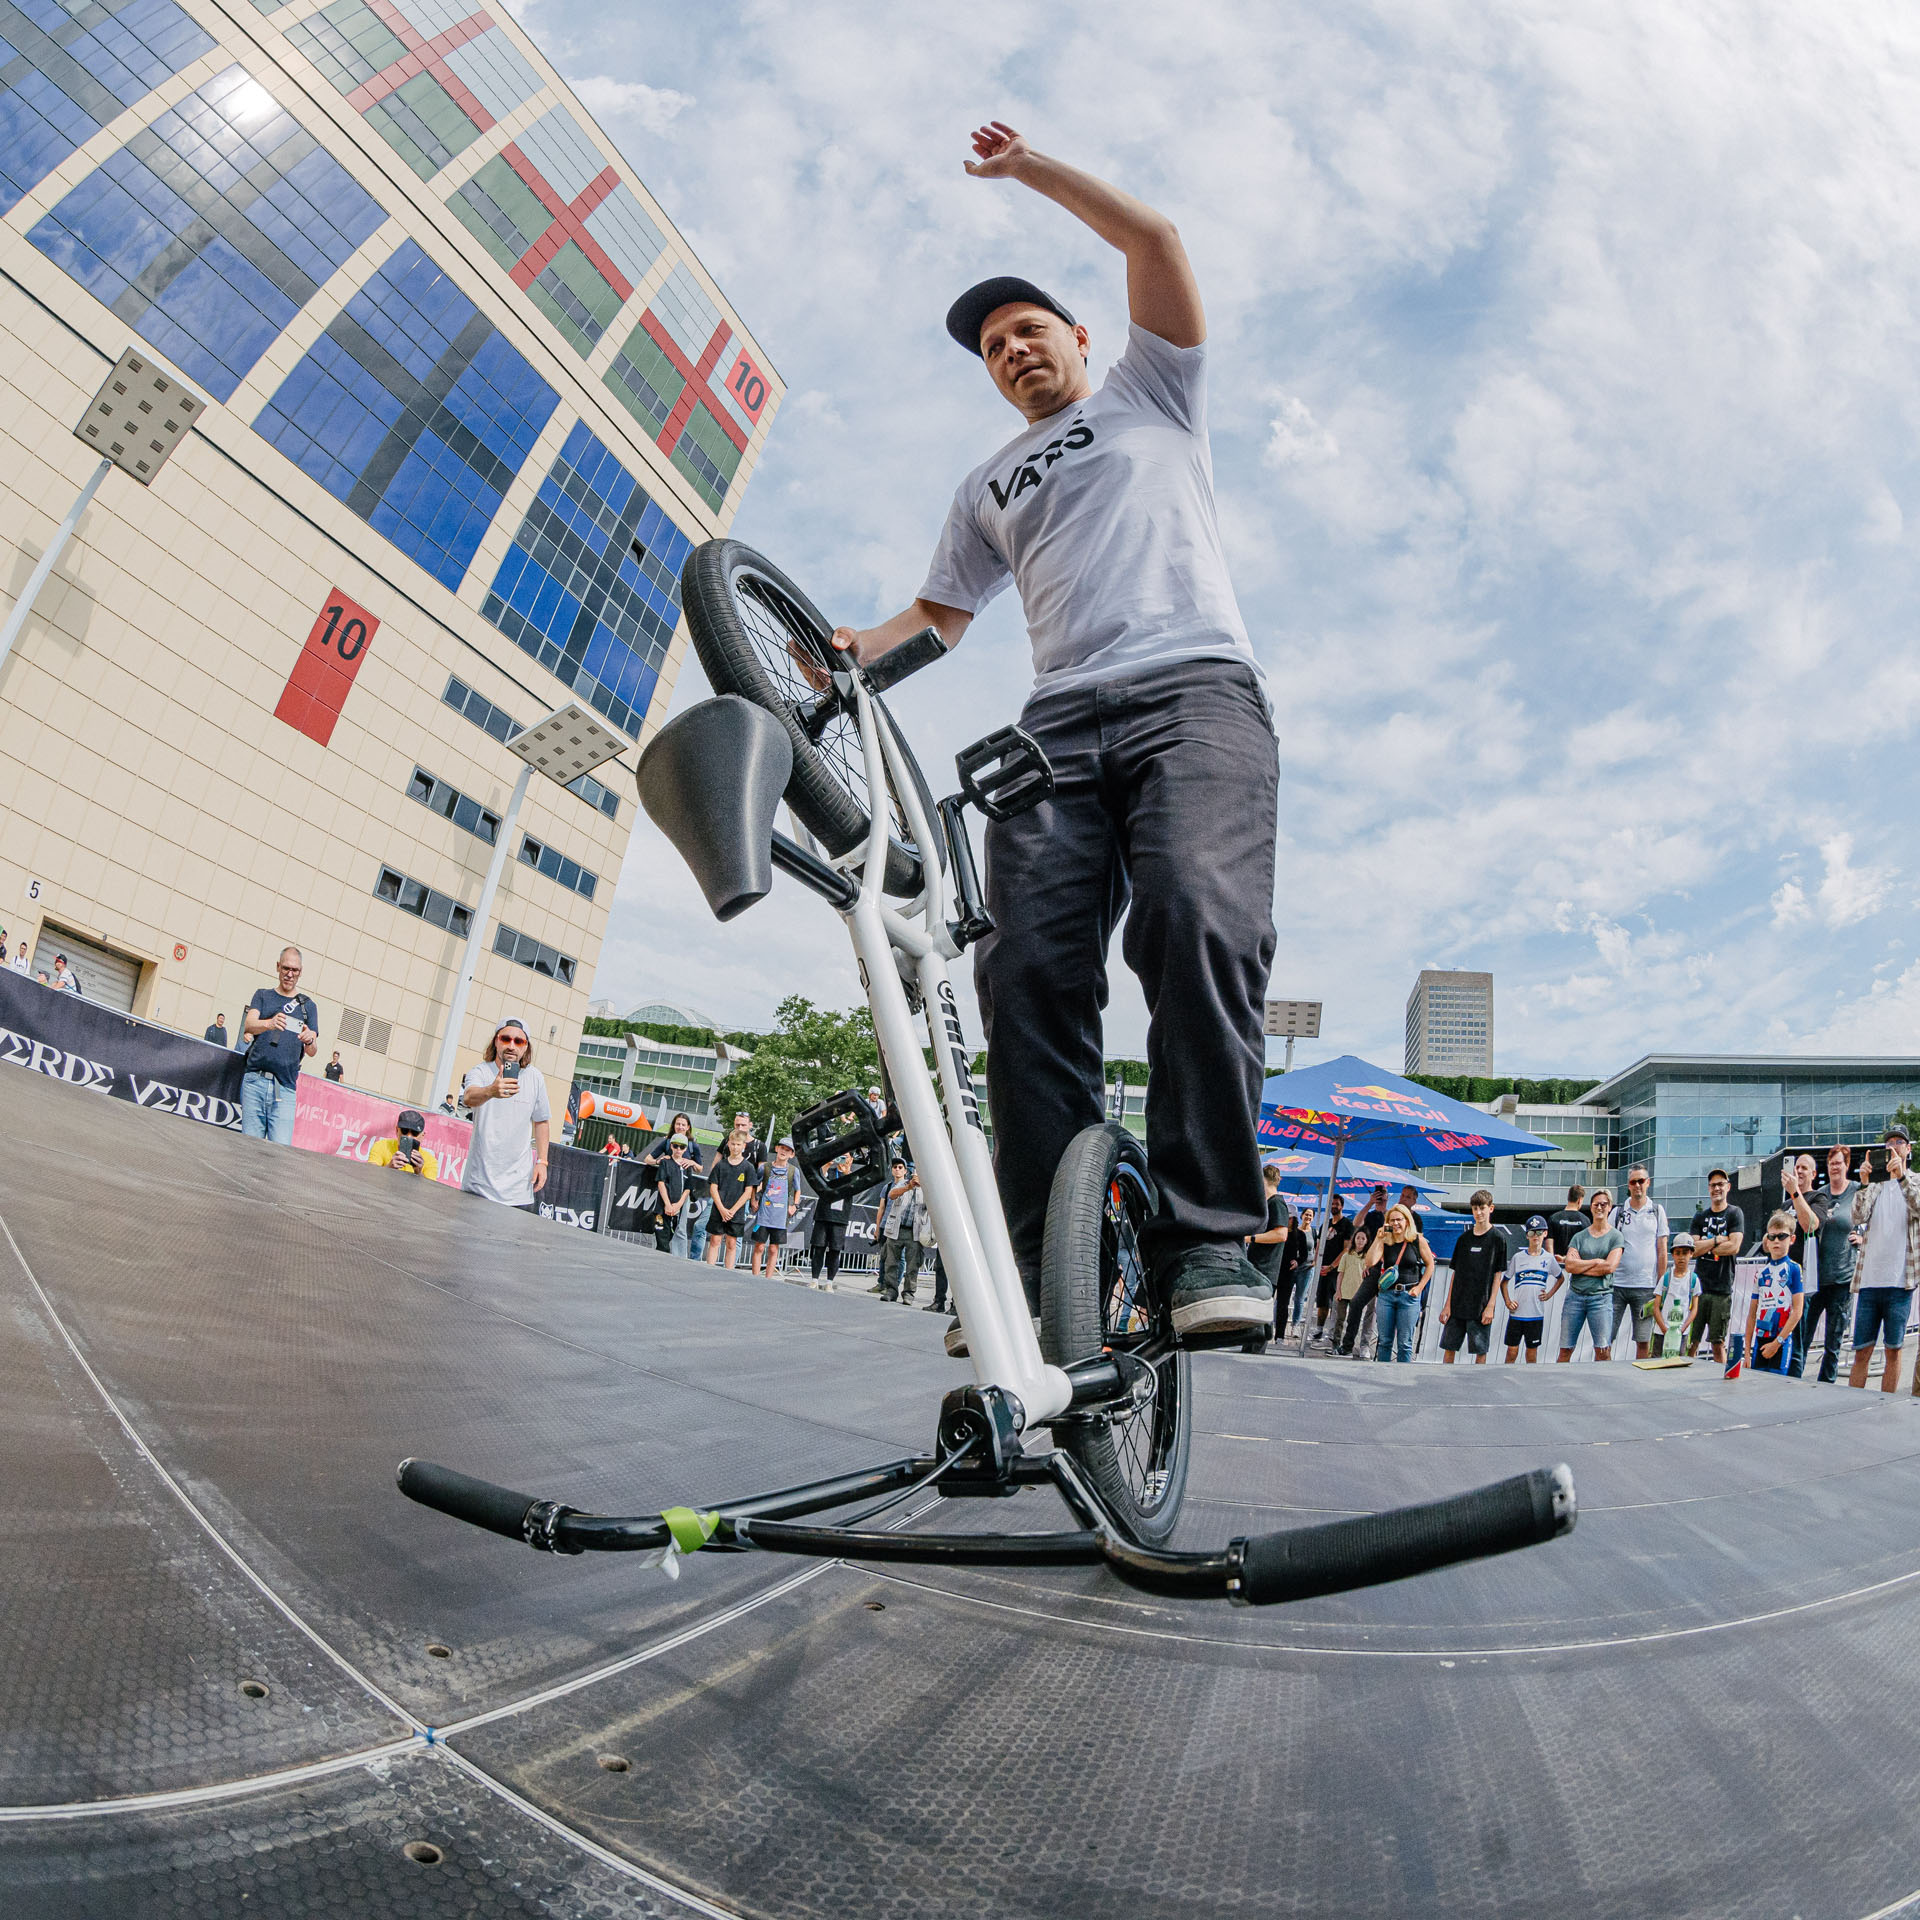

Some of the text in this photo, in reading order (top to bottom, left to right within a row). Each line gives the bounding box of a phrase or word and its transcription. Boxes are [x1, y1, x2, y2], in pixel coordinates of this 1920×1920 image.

[735, 361, 765, 411] 10
[321, 605, 367, 660] 10
[29, 880, 41, 899] 5
[0, 1027, 115, 1095] ERDE
[606, 1104, 630, 1116] BAFANG
[1329, 1095, 1450, 1123] Red Bull
